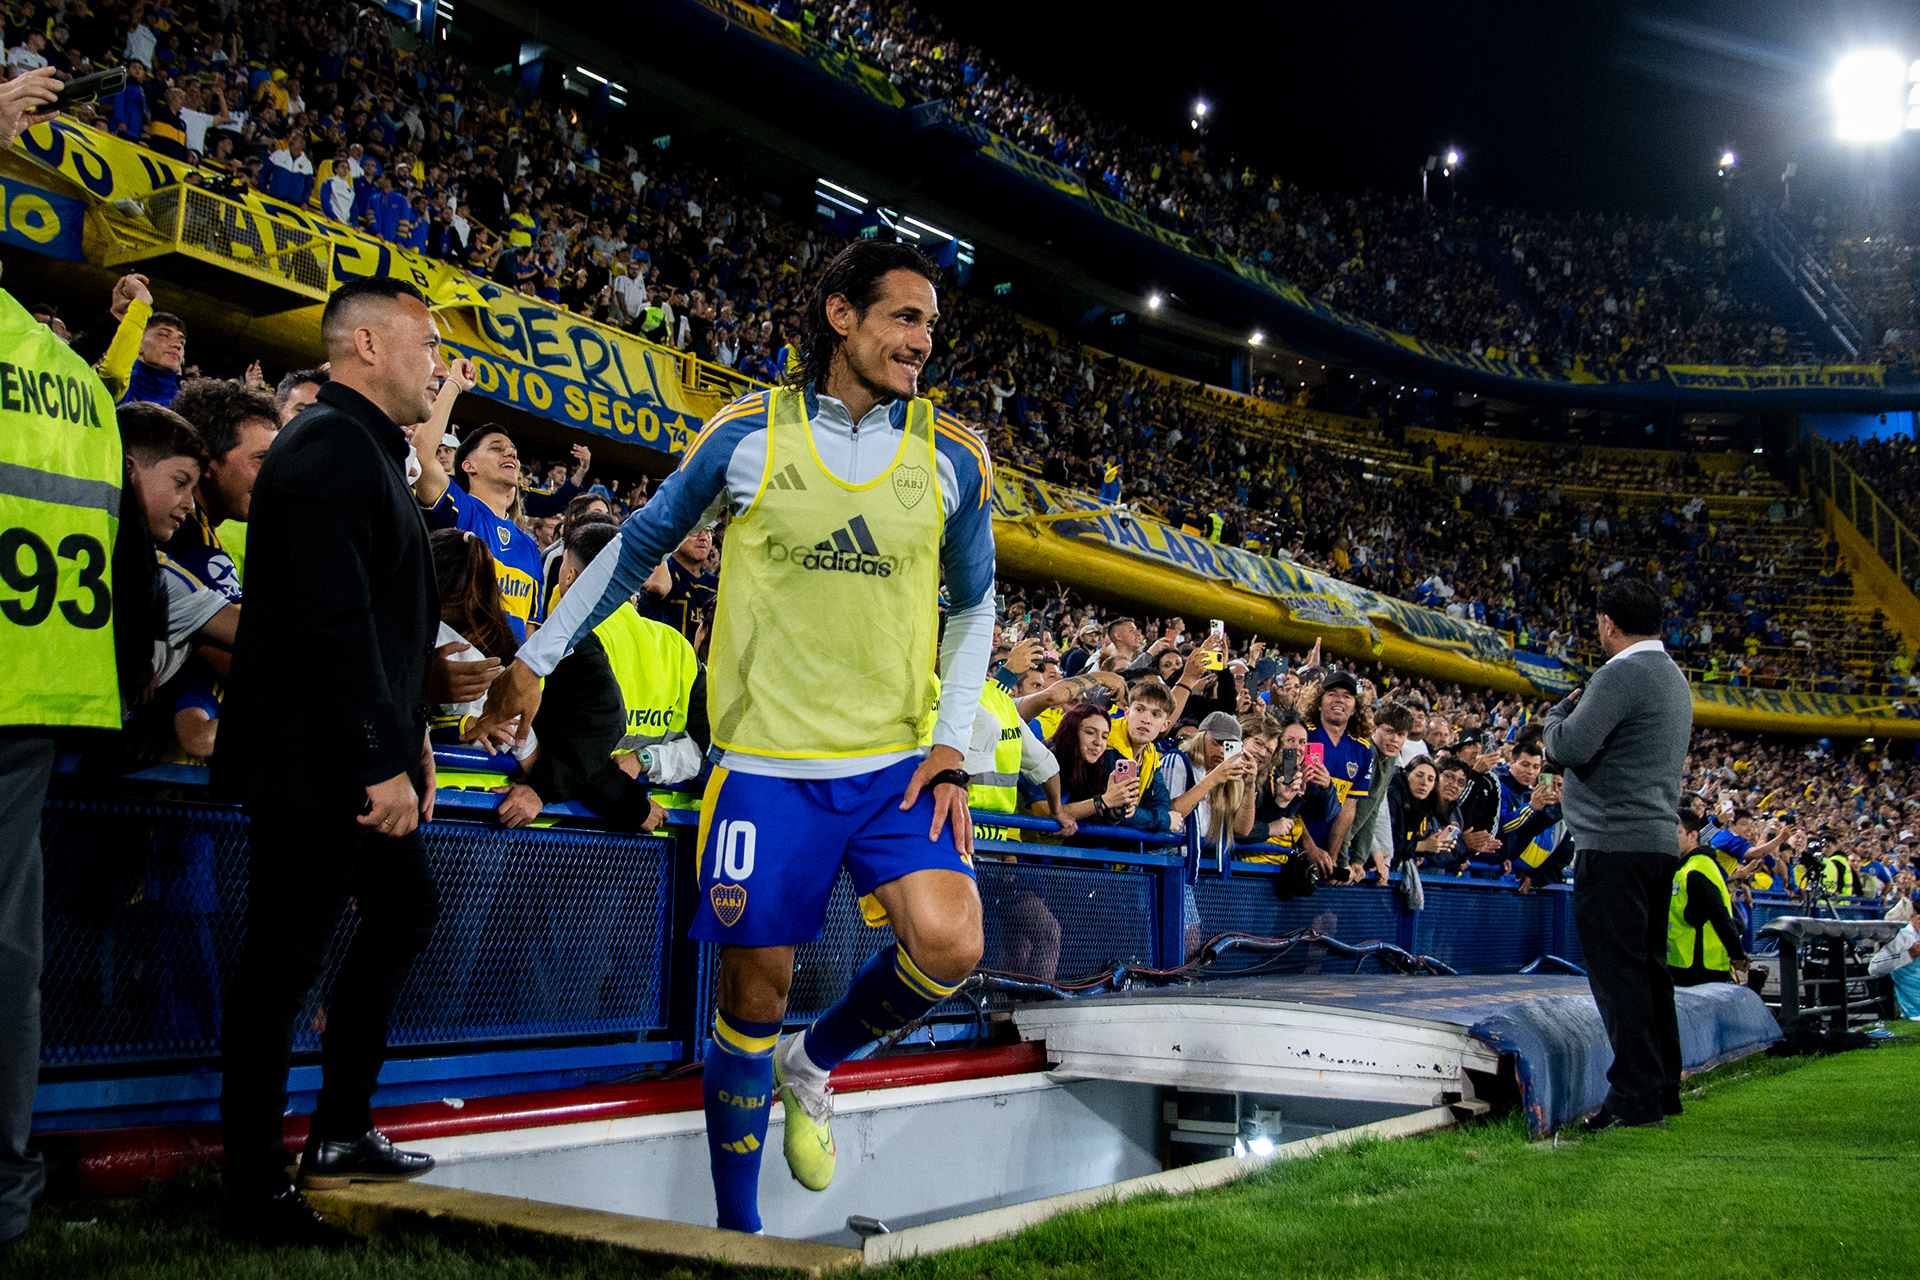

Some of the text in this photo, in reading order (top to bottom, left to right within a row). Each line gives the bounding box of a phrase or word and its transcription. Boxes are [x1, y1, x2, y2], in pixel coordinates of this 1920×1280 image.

[440, 343, 661, 442] OYO SECO
[670, 426, 689, 446] 74
[896, 478, 924, 490] CABJ
[802, 551, 892, 578] adidas
[0, 526, 112, 630] 93
[713, 818, 757, 881] 10
[715, 897, 742, 908] CABJ
[718, 1089, 766, 1109] CABJ
